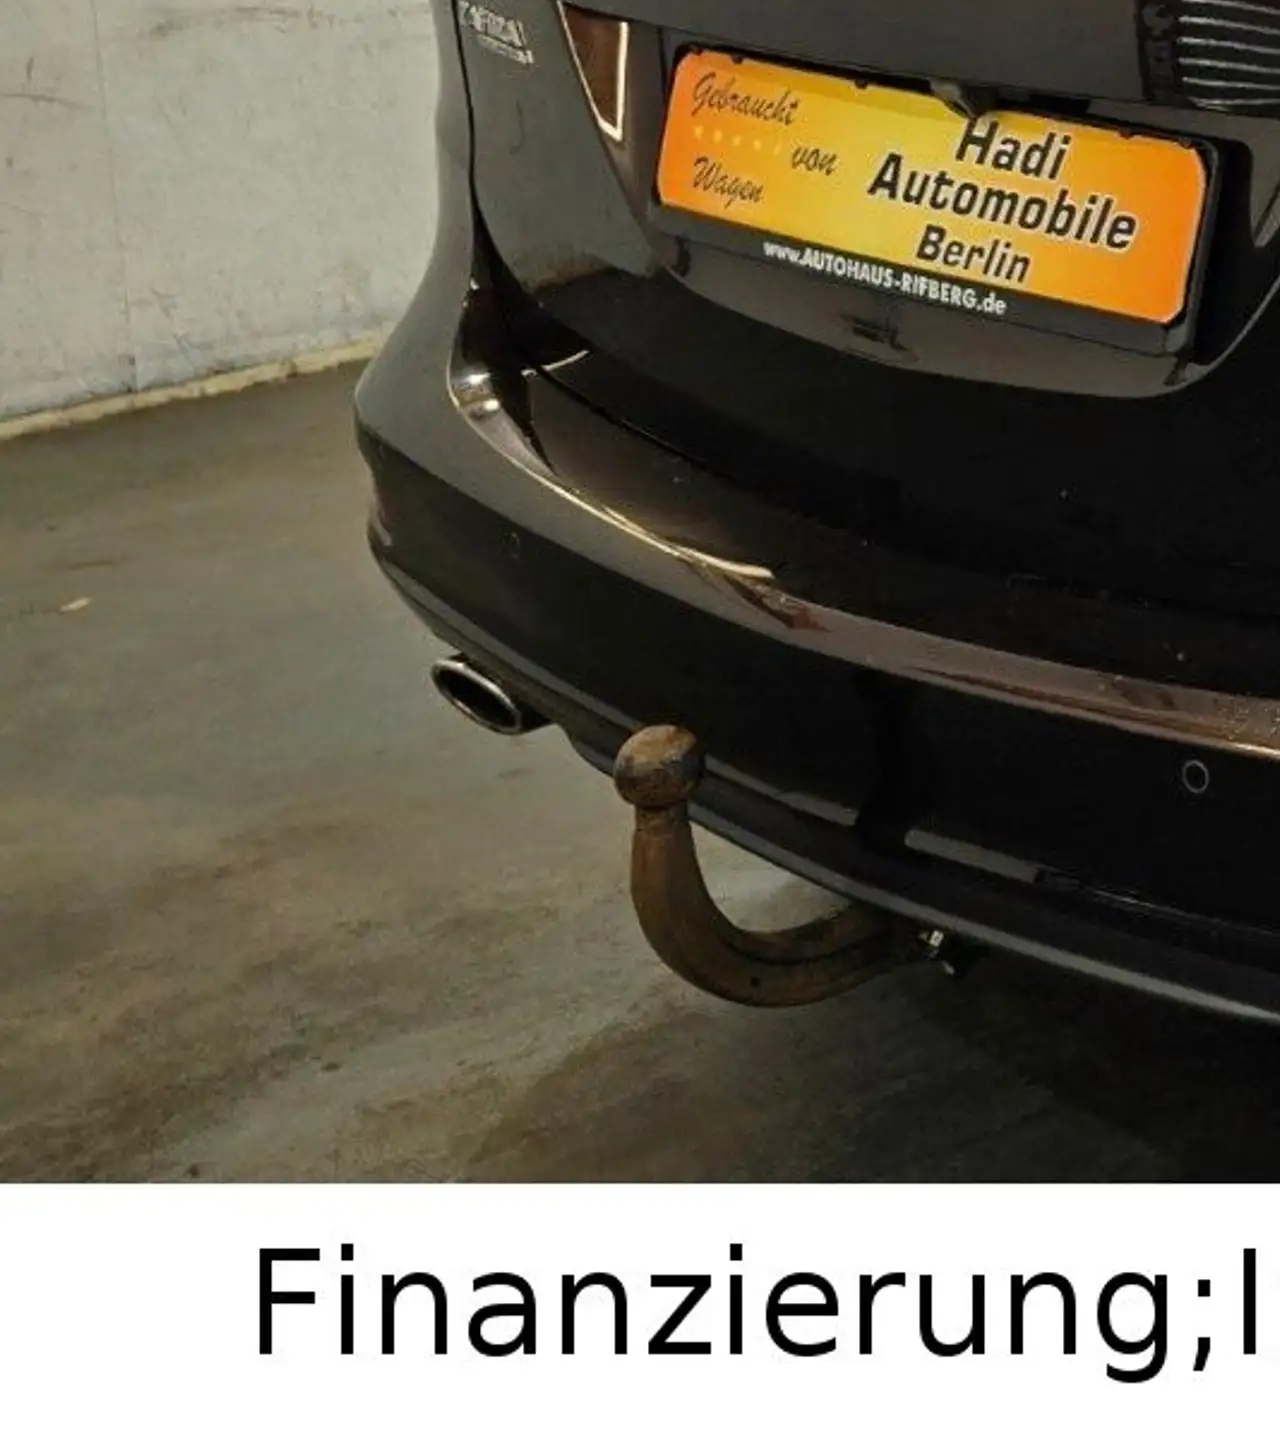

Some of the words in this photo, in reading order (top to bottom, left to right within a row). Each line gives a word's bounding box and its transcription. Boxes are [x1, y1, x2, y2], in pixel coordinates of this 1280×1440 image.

[691, 72, 800, 126] Gebraucht
[791, 146, 838, 176] von
[954, 117, 1073, 181] Hadi
[693, 156, 765, 209] Wagen
[867, 152, 1138, 250] Automobile
[762, 241, 1008, 316] www.AUTOHAUS-RIFBERG.de
[915, 224, 1032, 284] Berlin
